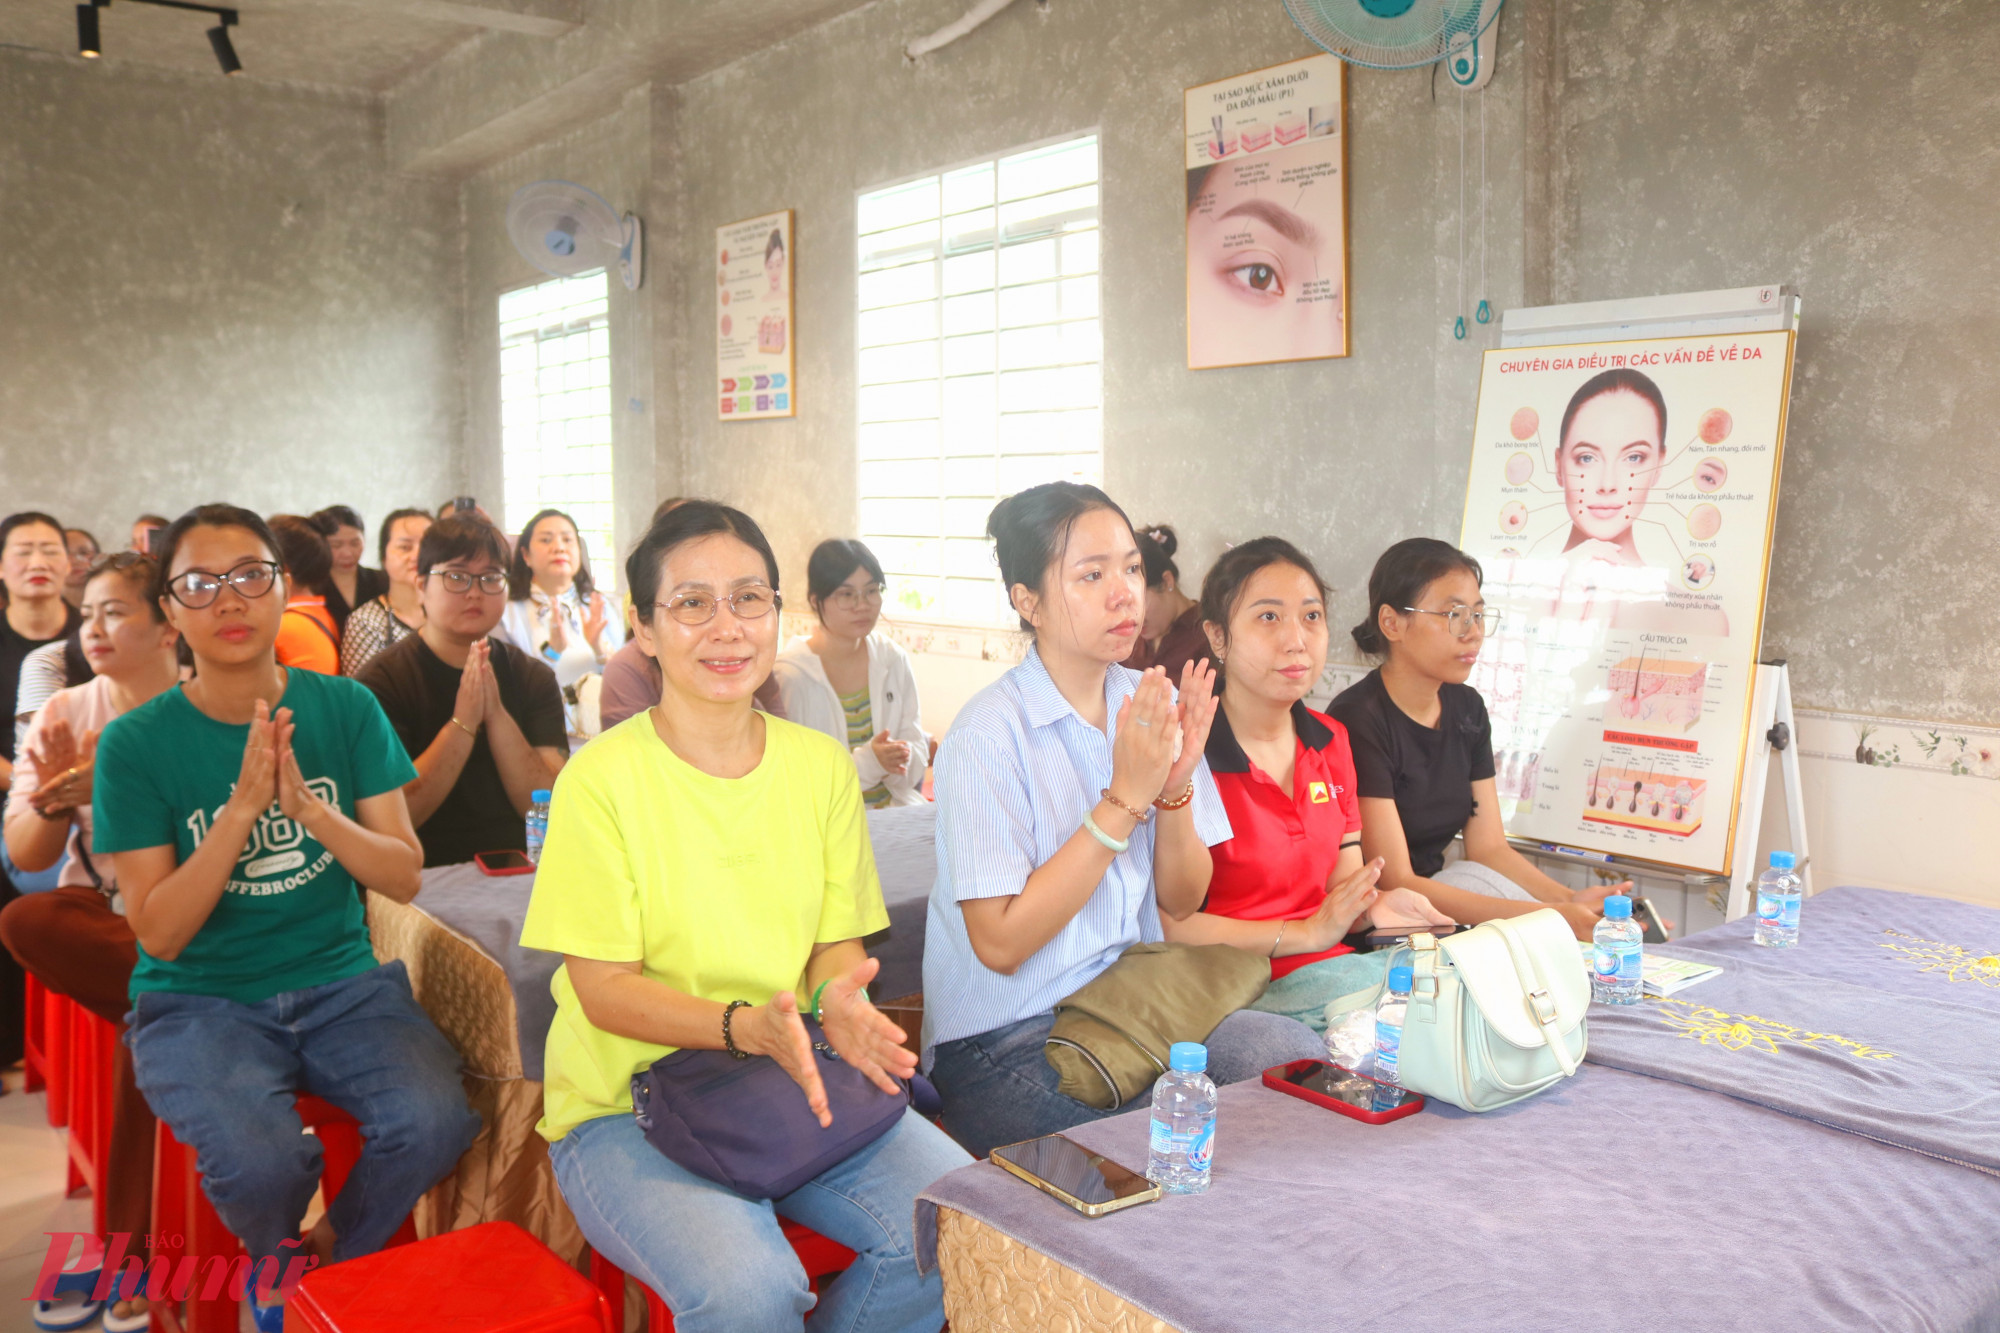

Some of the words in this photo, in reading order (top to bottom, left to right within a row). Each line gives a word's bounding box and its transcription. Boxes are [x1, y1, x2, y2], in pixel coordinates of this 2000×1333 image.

[1228, 87, 1242, 99] SAO
[1227, 103, 1238, 112] DA
[1500, 358, 1549, 373] CHUYÊN
[1553, 359, 1573, 370] GIA
[1611, 355, 1626, 369] TRỊ
[1630, 350, 1659, 366] CÁC
[1664, 347, 1692, 364] VẤN
[1742, 348, 1762, 360] DA
[1698, 493, 1717, 501] không
[1640, 633, 1655, 642] CẤU
[1656, 635, 1673, 644] TRÚC
